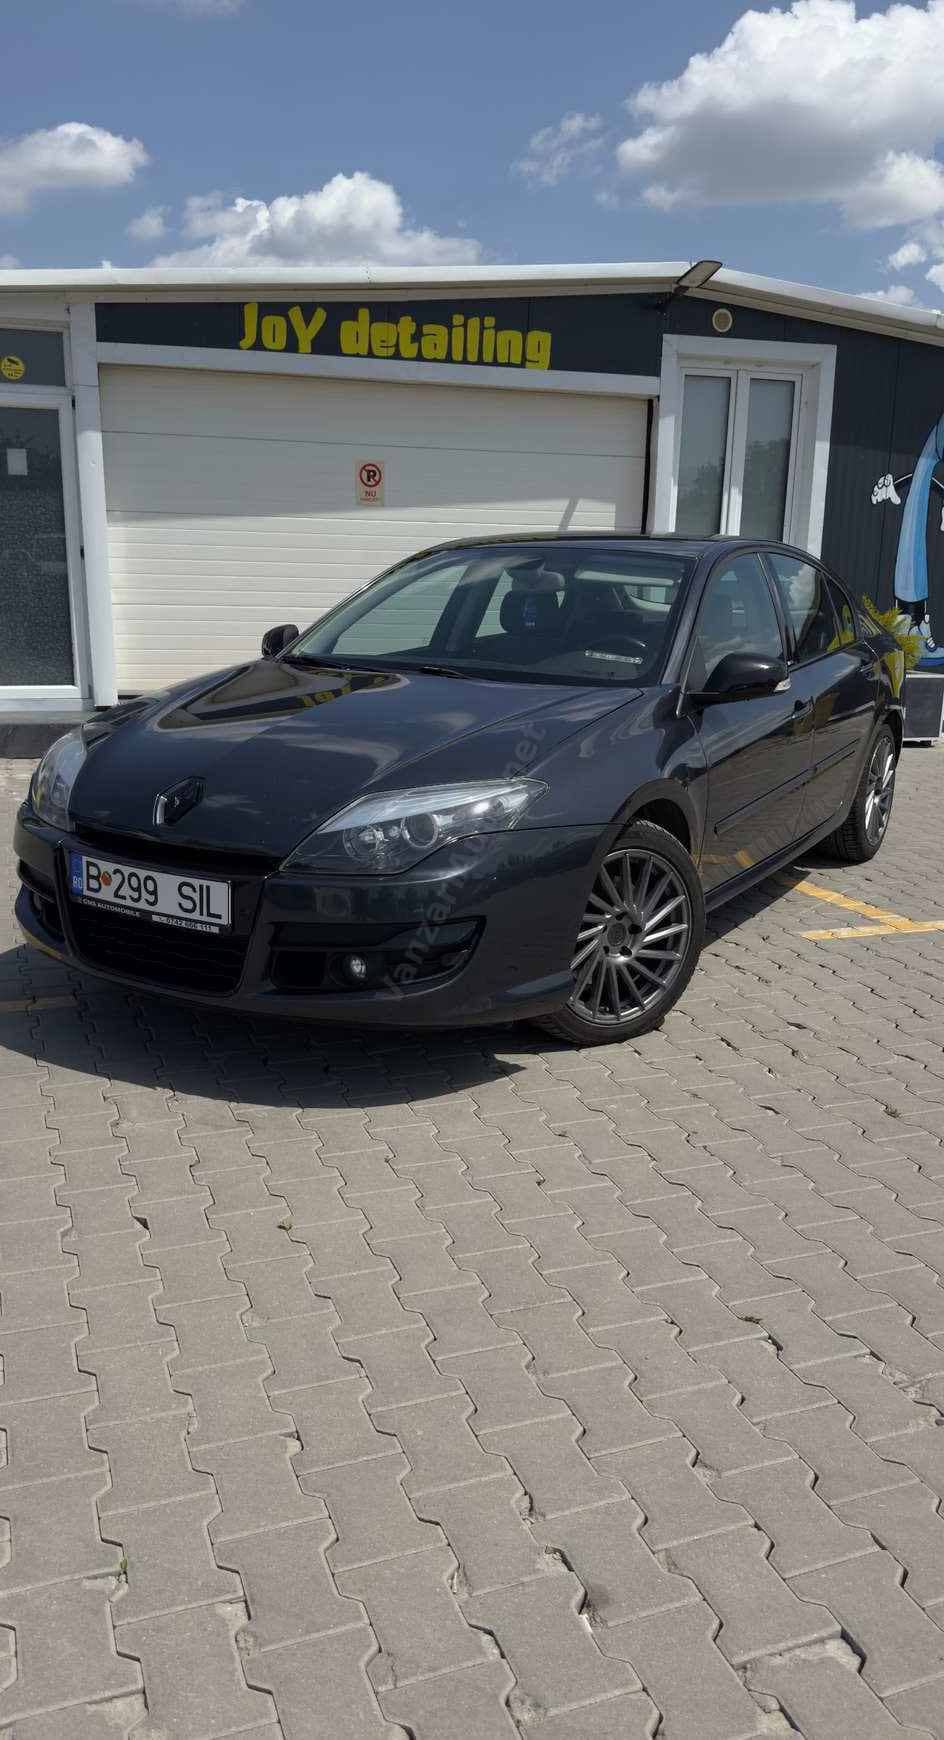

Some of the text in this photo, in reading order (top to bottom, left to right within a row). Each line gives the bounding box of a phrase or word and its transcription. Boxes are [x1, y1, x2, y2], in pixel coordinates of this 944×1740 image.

[339, 307, 552, 370] detailing
[72, 875, 83, 889] RO
[86, 860, 222, 920] B 299 SIL
